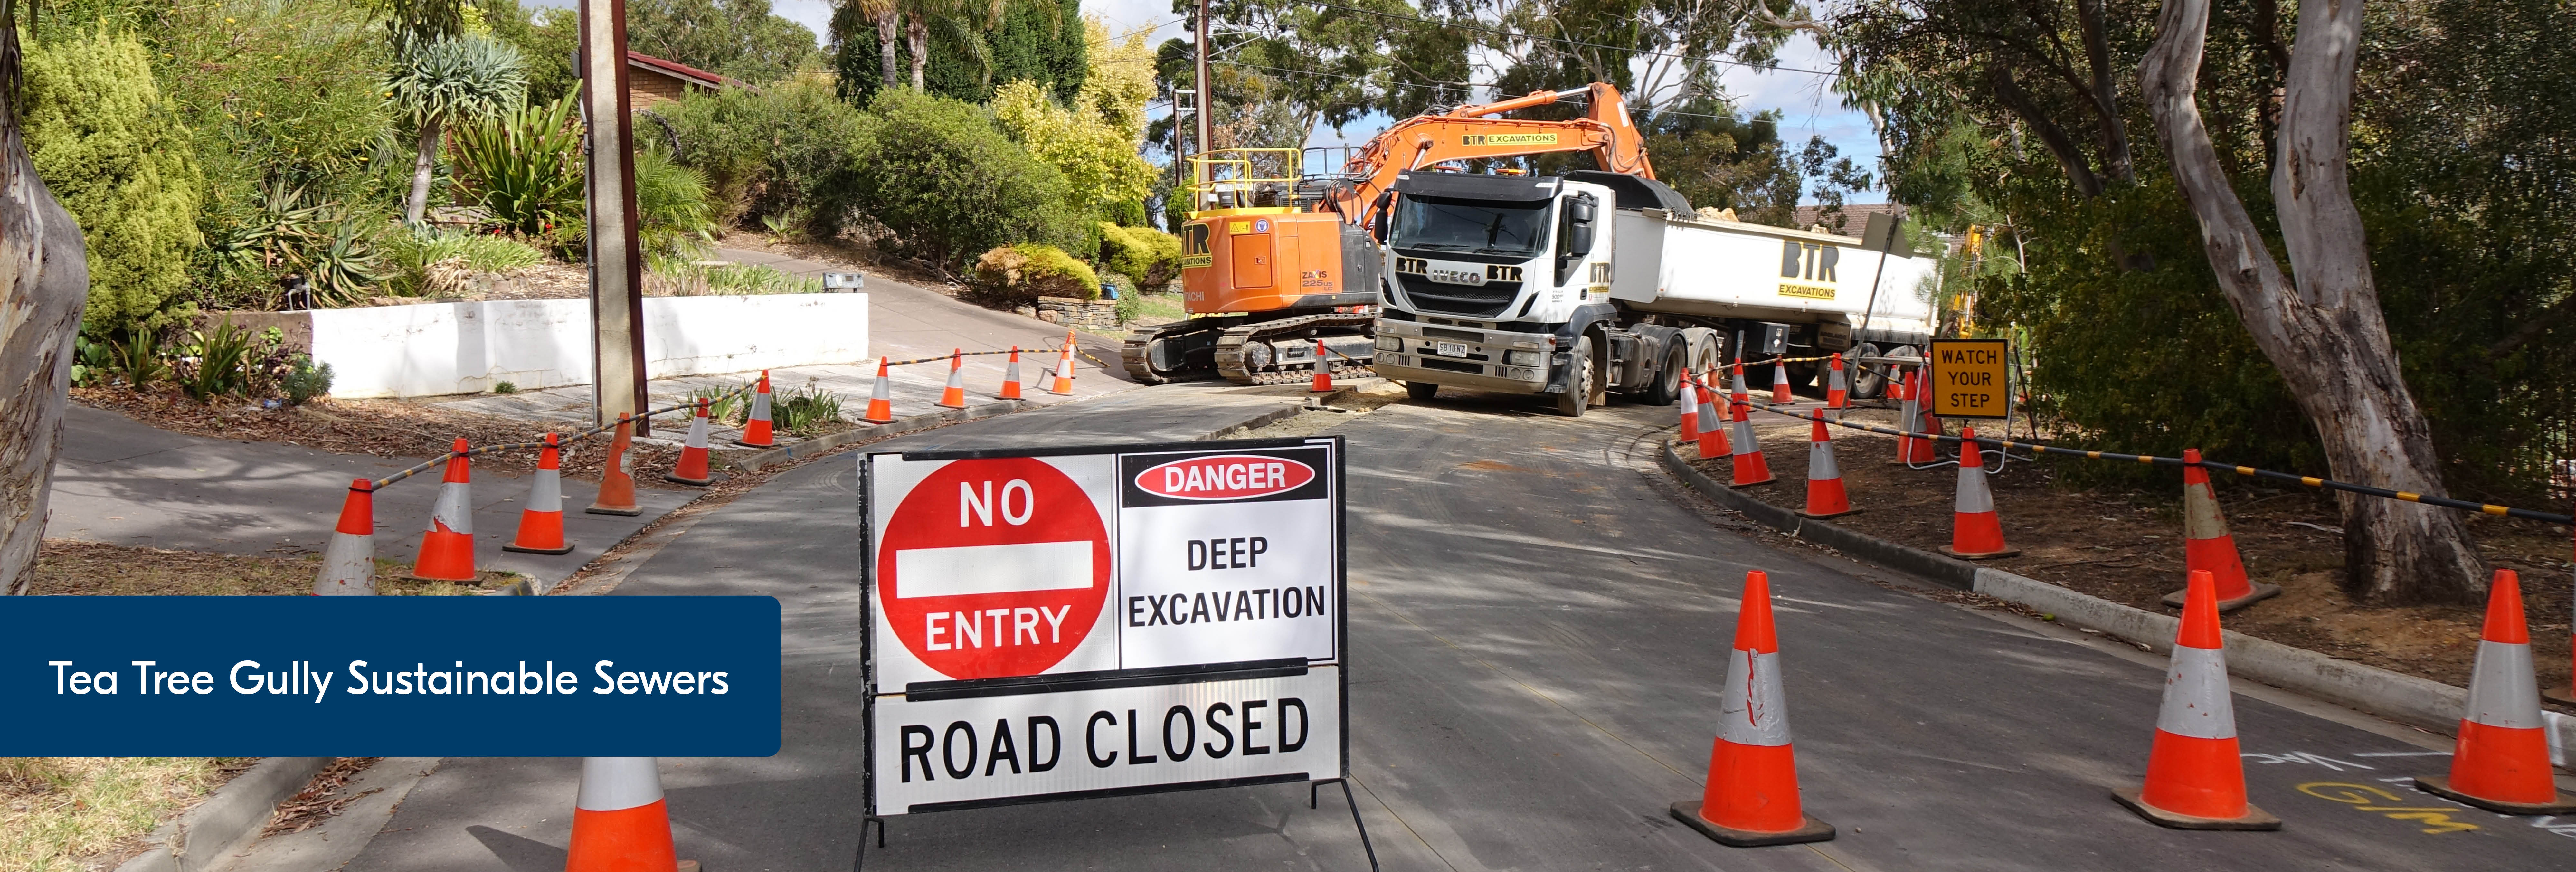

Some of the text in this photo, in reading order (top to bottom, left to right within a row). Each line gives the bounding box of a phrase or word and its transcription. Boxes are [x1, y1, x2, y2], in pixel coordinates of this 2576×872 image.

[1463, 136, 1485, 145] BTR
[1182, 224, 1210, 255] TR
[1396, 257, 1428, 274] BTR
[1781, 240, 1839, 282] BTR
[1302, 270, 1327, 279] ZAXIS
[1433, 269, 1481, 284] IVECO
[1487, 265, 1523, 281] BTR
[1590, 263, 1610, 283] BTR
[1779, 285, 1835, 298] EXCAVATIONS
[1942, 350, 1996, 364] WATCH
[1948, 372, 1991, 386] YOUR
[1951, 393, 1990, 408] STEP
[1164, 460, 1286, 493] DANGER
[961, 479, 1034, 527] NO
[1188, 537, 1267, 570] DEEP
[1129, 586, 1324, 627] EXCAVATION
[926, 605, 1071, 651] ENTRY
[901, 697, 1308, 783] ROAD CLOSED
